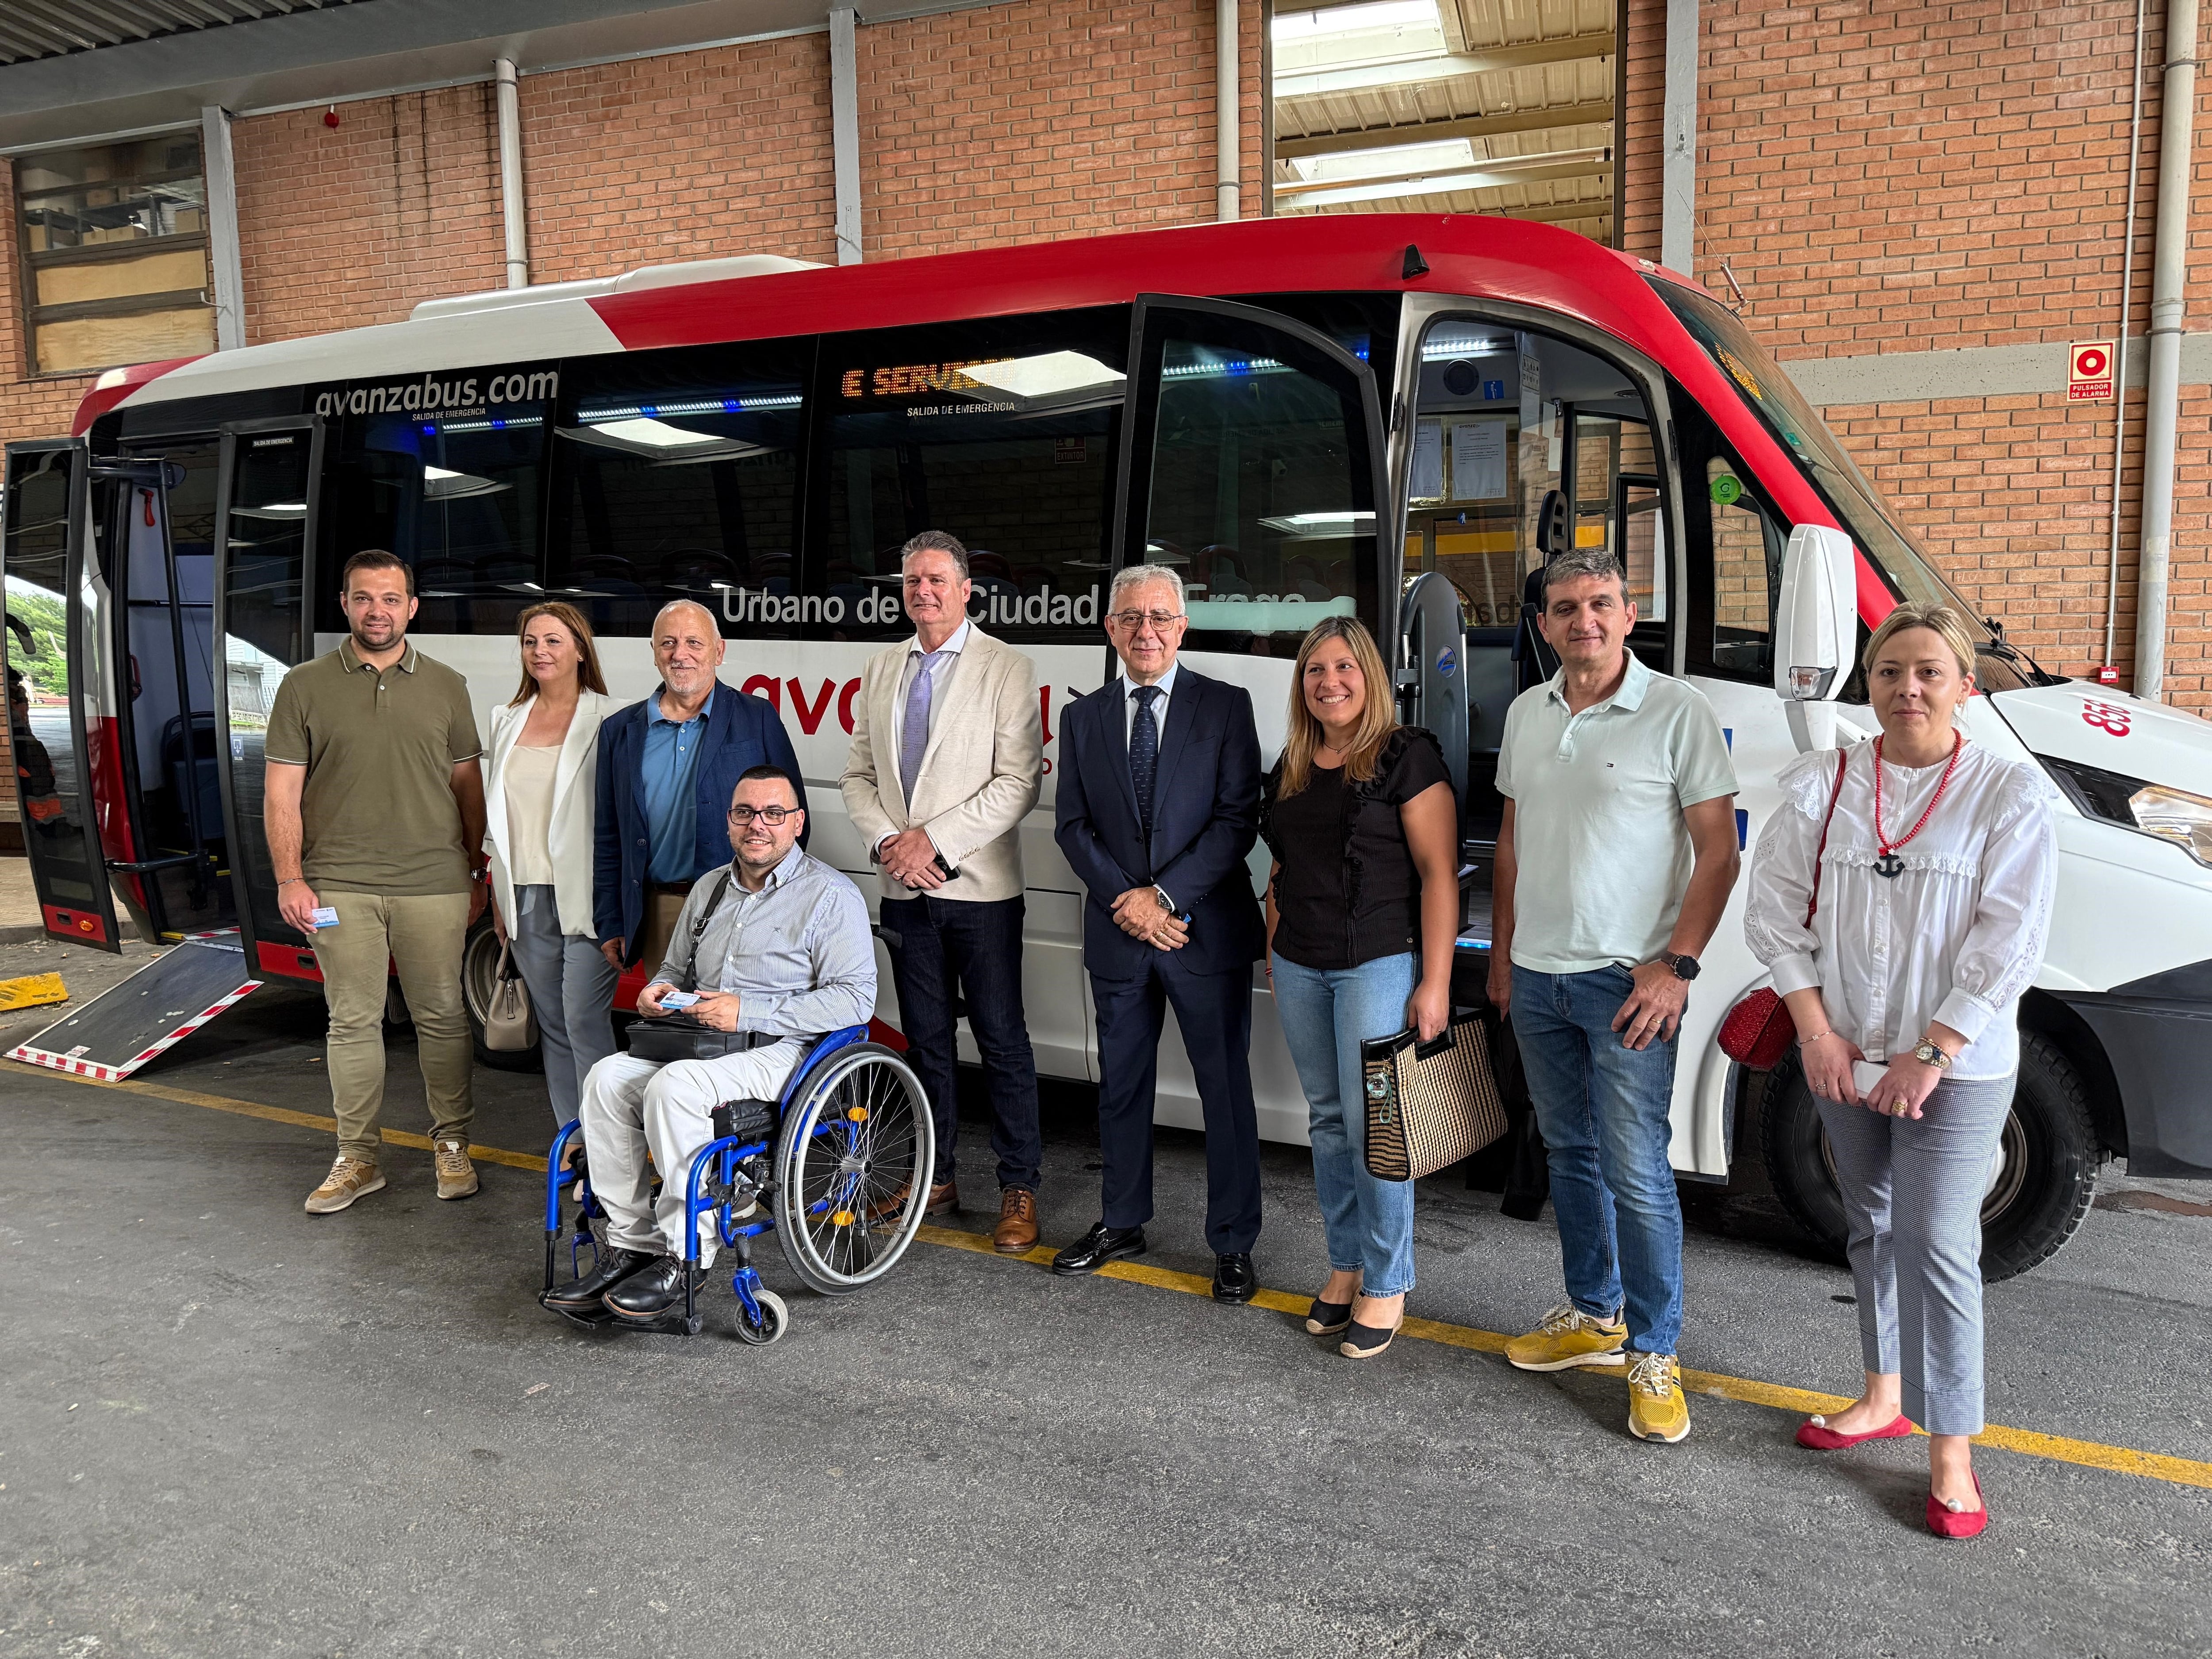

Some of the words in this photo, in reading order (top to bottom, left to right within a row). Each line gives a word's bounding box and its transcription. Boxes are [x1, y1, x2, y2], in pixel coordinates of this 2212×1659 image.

[315, 371, 558, 417] avanzabus.com
[412, 412, 434, 421] SALIDA
[445, 407, 486, 418] EMERGENCIA
[907, 407, 939, 417] SALIDA
[941, 405, 953, 415] DE
[956, 402, 1015, 414] EMERGENCIA
[1057, 451, 1084, 461] EXTINTOR
[723, 587, 845, 623] Urbano
[856, 586, 899, 623] de
[964, 584, 1099, 624] Ciudad
[2082, 699, 2131, 737] 856
